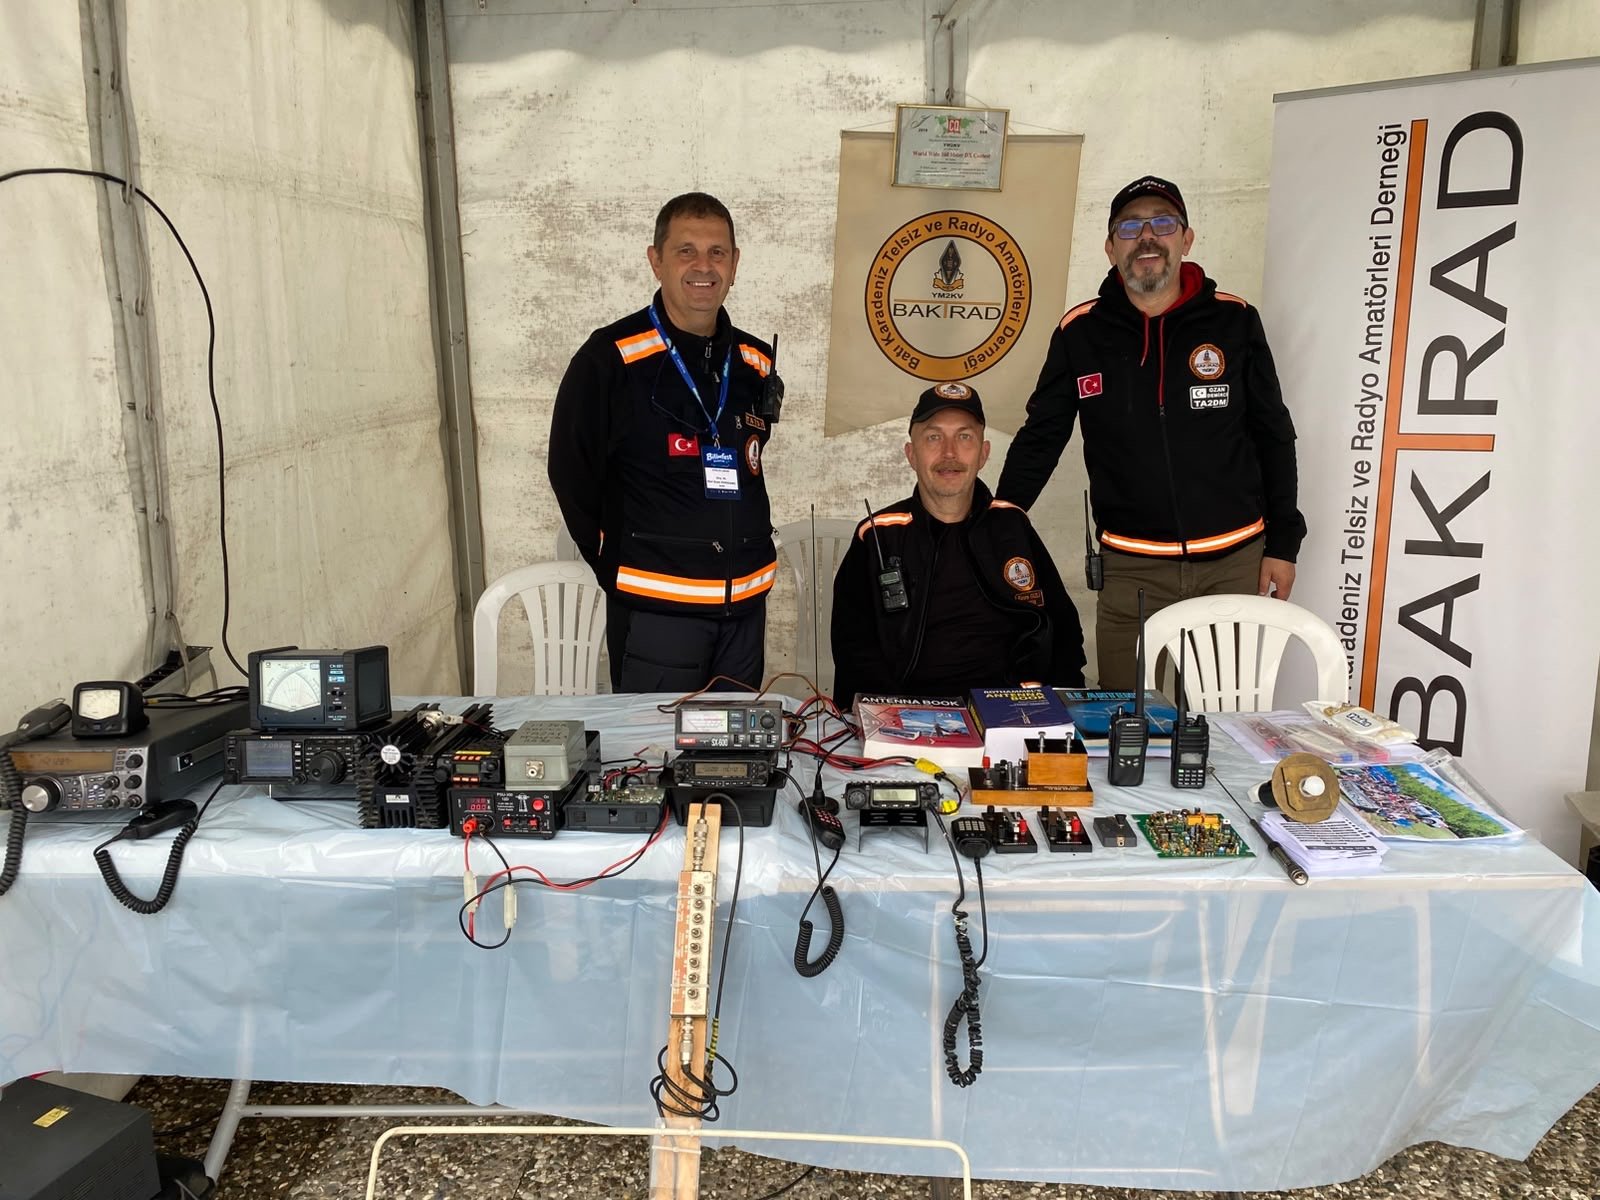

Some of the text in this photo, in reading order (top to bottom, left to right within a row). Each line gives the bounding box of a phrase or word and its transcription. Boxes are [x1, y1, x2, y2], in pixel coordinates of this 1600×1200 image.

[949, 119, 960, 132] CQ
[1370, 123, 1408, 225] Derneği
[924, 220, 943, 233] ve
[948, 216, 996, 243] Radyo
[882, 227, 922, 263] Telsiz
[931, 292, 964, 300] YM2KV
[994, 240, 1026, 324] Amatörleri
[871, 266, 895, 347] Karadeniz
[892, 300, 1002, 320] BAKTRAD
[1358, 234, 1393, 365] Amatörleri
[892, 344, 921, 370] Batı
[963, 324, 1017, 374] Derneği
[1194, 400, 1227, 408] TA2DM
[1350, 372, 1384, 452] Radyo
[1352, 460, 1373, 489] ve
[1340, 495, 1369, 565] Telsiz
[862, 696, 960, 707] ANTENNA BOOK
